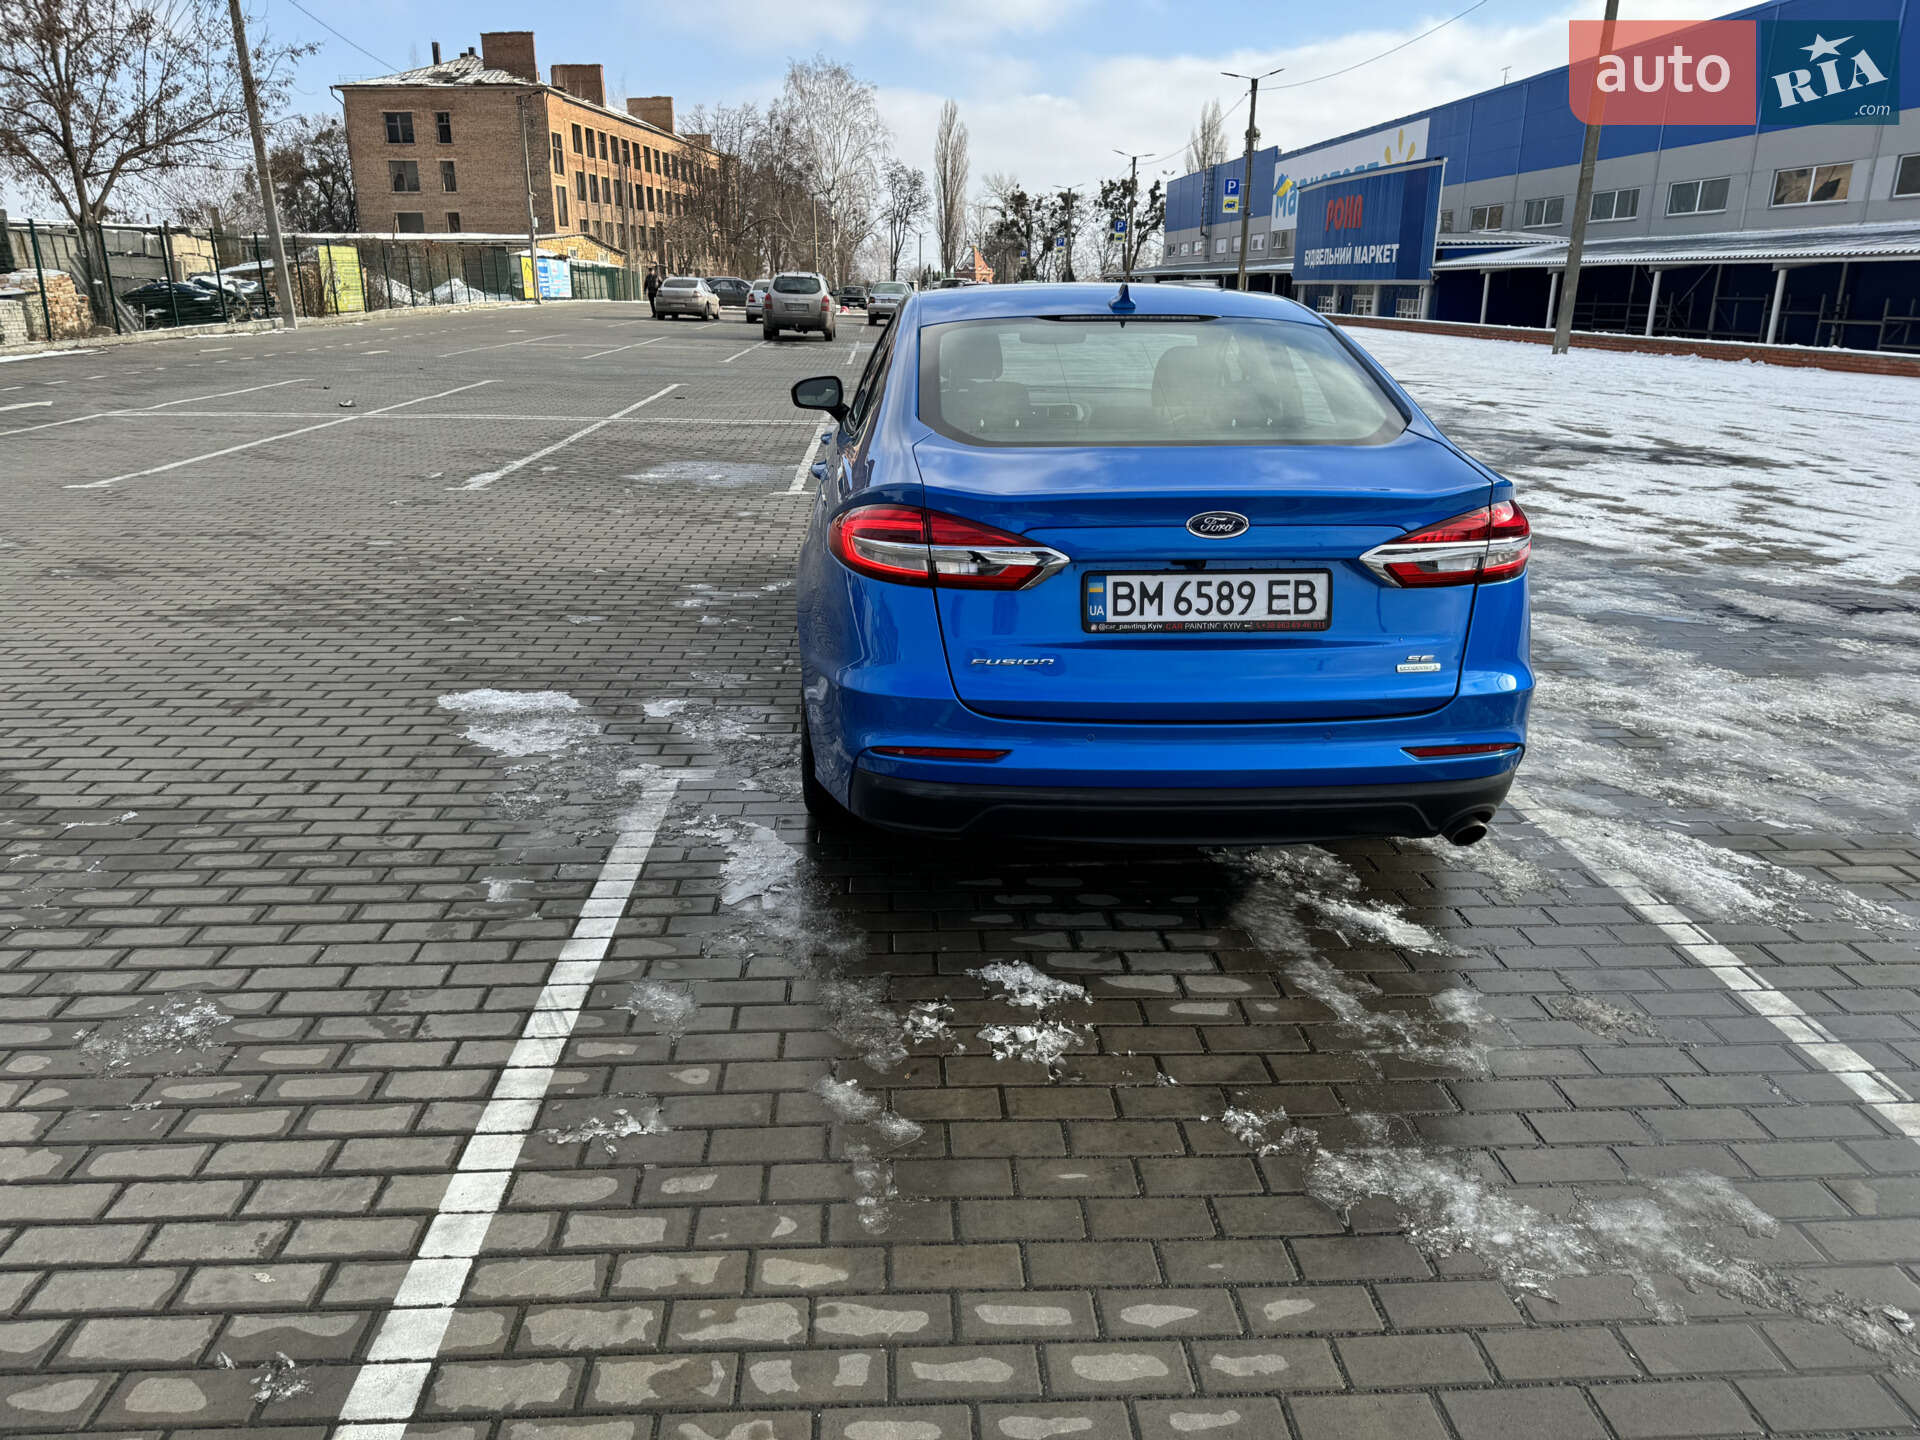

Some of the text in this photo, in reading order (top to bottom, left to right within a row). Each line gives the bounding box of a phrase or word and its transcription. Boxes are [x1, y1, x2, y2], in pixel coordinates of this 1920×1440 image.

[1353, 243, 1400, 264] МАРКЕТ
[1200, 517, 1236, 532] Ford
[1112, 579, 1318, 616] BM 6589 EB
[1089, 605, 1105, 616] UA
[1223, 621, 1241, 630] KYIV
